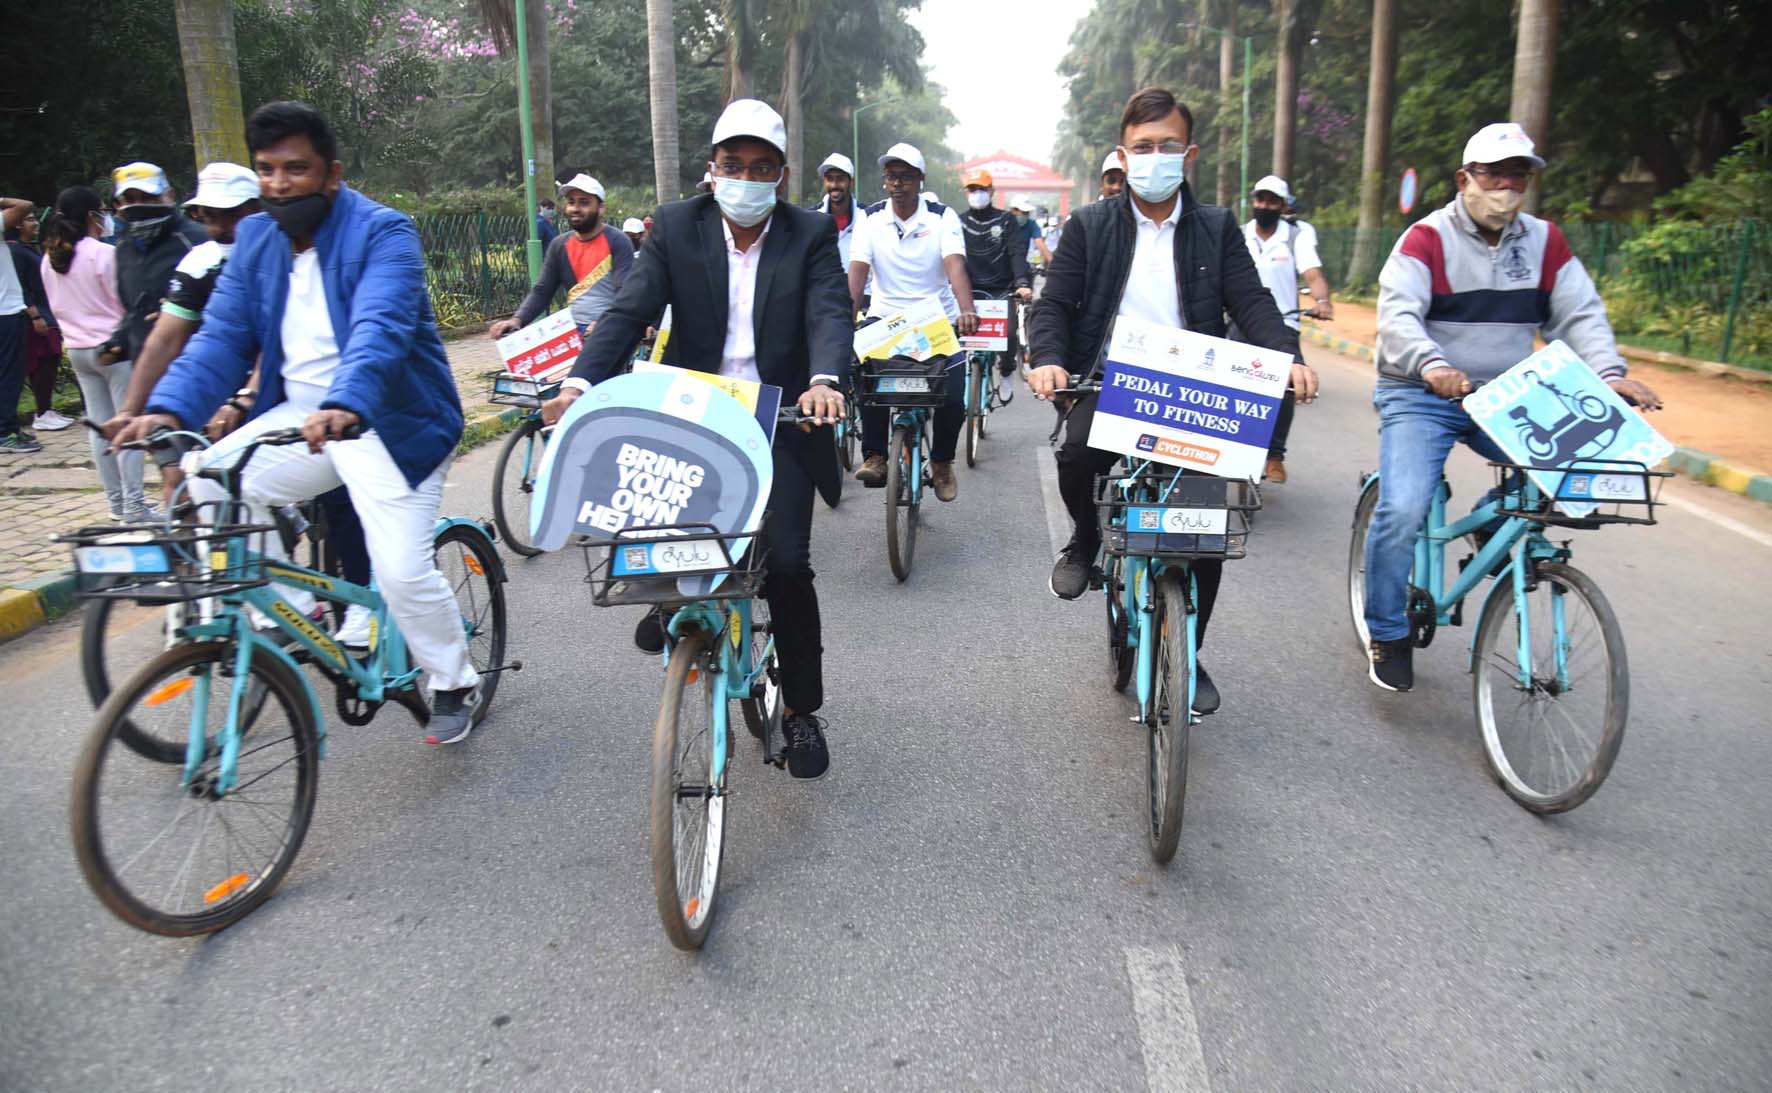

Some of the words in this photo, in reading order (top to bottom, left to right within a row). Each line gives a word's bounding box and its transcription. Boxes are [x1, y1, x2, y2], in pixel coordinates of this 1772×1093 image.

[1112, 372, 1173, 399] PEDAL
[1178, 387, 1228, 411] YOUR
[1234, 399, 1272, 420] WAY
[1133, 399, 1159, 416] TO
[1163, 405, 1241, 434] FITNESS
[616, 443, 705, 488] BRING
[1157, 441, 1217, 463] CYCLOTHON
[618, 465, 693, 508] YOUR
[611, 488, 681, 526] OWN
